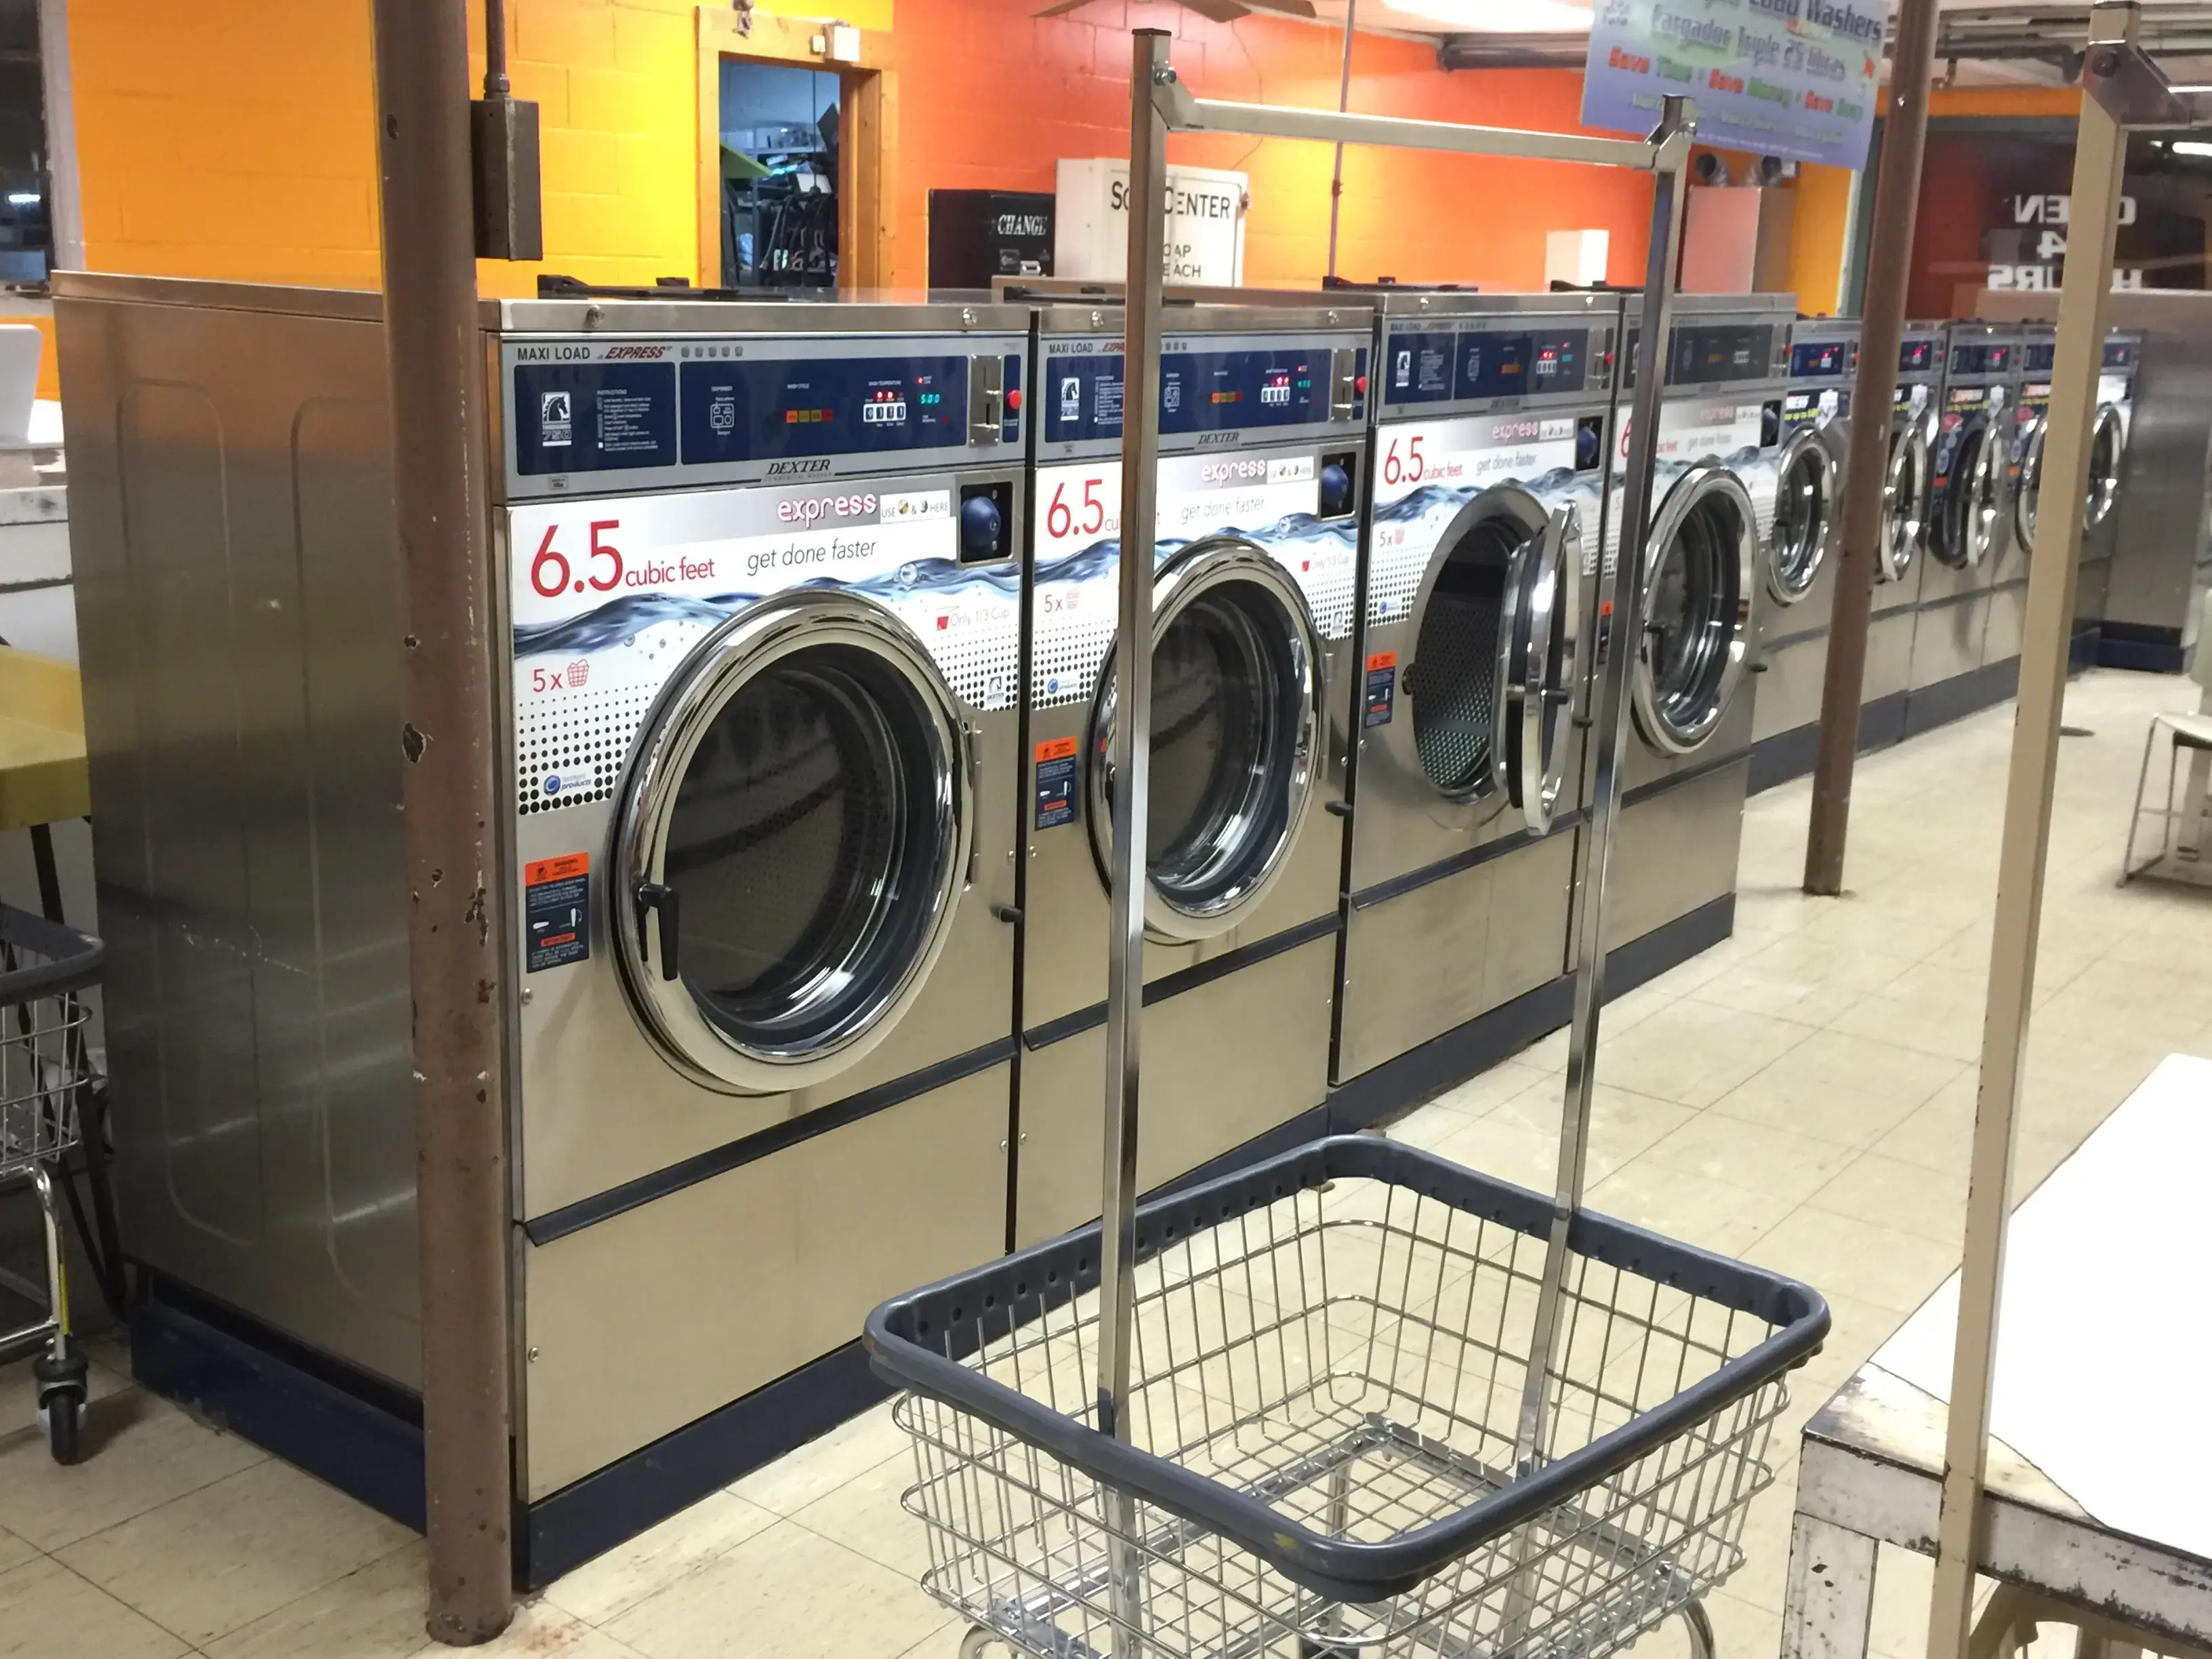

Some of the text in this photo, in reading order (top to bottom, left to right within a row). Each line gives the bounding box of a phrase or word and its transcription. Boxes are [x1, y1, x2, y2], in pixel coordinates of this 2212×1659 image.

[1750, 0, 1883, 40] ad Washers
[1739, 26, 1780, 58] Triple
[1164, 186, 1231, 219] CENTER
[997, 214, 1048, 236] CHANGE
[1163, 243, 1191, 258] OAP
[1163, 263, 1202, 278] EACH
[518, 346, 667, 361] MAXI LOAD EXPRESS
[1048, 342, 1125, 353] MAXI LOAD EXPR
[1197, 432, 1240, 445] DEXTER
[1492, 421, 1538, 443] express
[767, 458, 832, 475] DEXTER
[1201, 459, 1267, 487] express
[1384, 436, 1424, 485] 6.5
[1446, 462, 1463, 478] feet
[1476, 451, 1537, 476] get done faster
[777, 493, 878, 529] express
[881, 508, 896, 518] USE
[930, 501, 949, 513] HERE
[1047, 479, 1104, 539] 6.5
[1181, 495, 1265, 524] get done faster
[531, 519, 623, 598] 6.5
[747, 538, 877, 576] get done faster
[625, 556, 716, 587] cubic feet
[950, 607, 1010, 626] Only 1/3 Cup
